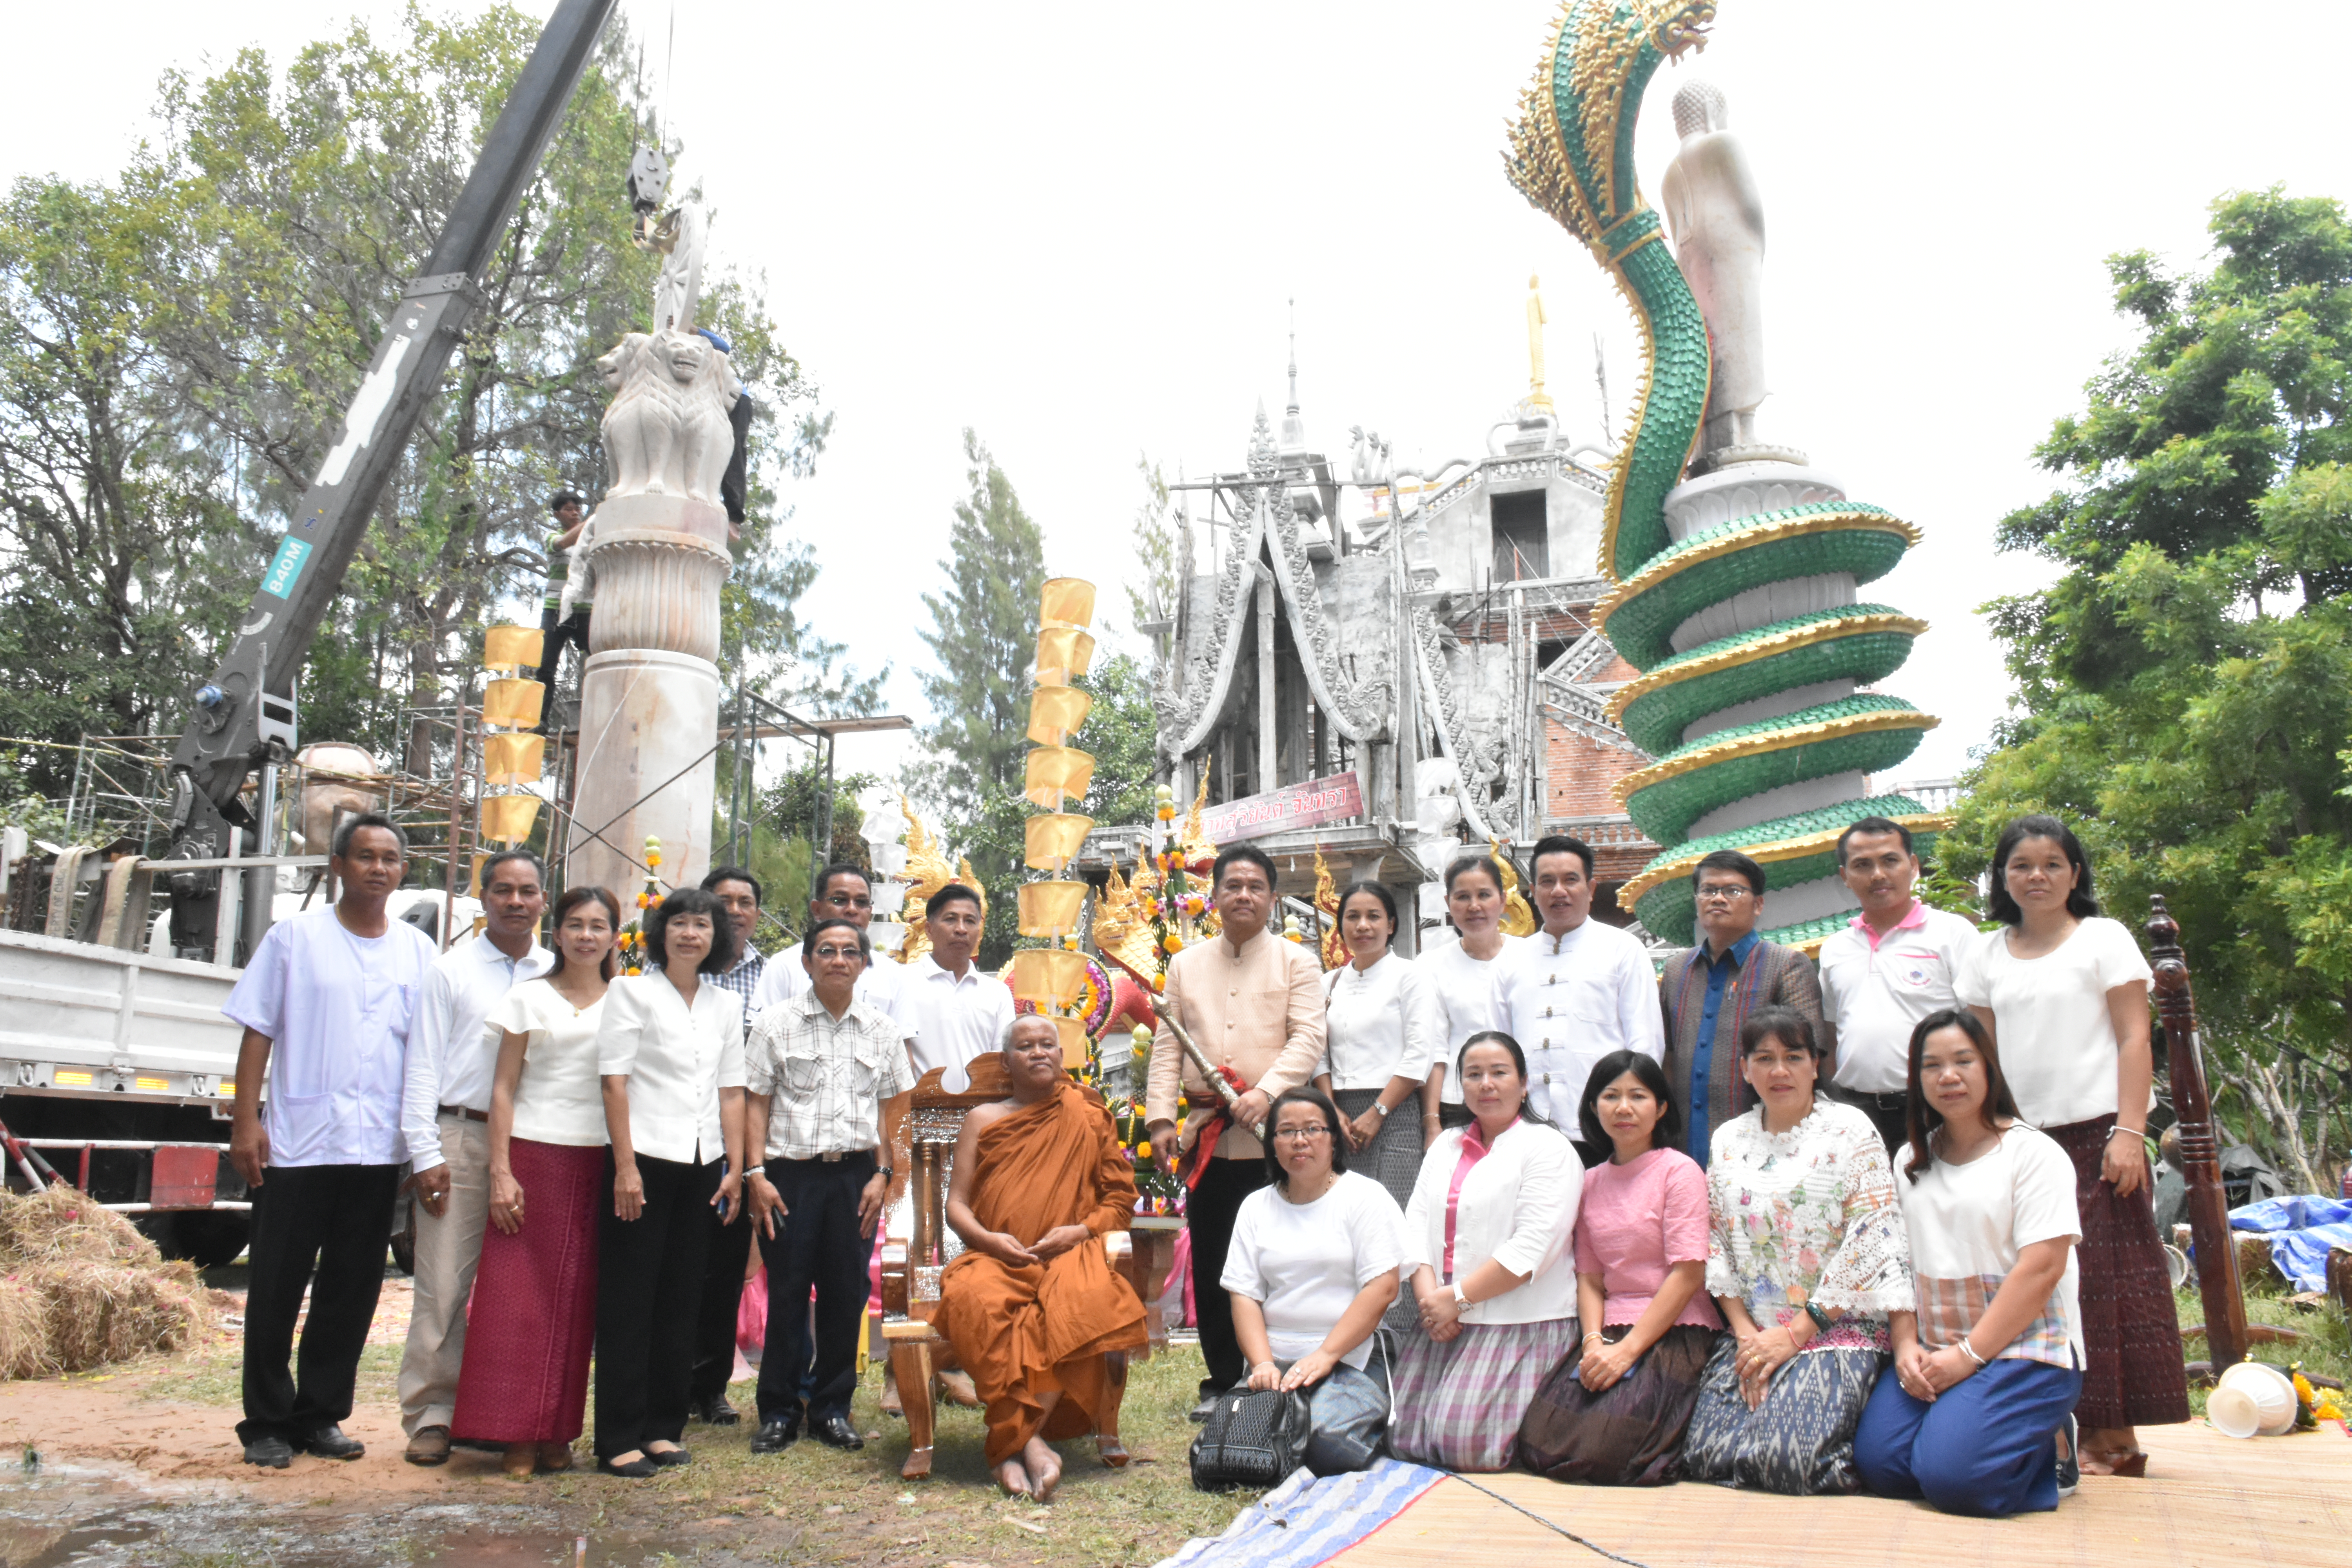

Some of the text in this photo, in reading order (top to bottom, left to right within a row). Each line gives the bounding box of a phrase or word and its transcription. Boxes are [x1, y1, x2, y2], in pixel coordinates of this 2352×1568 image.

[269, 542, 303, 593] 840M
[1291, 787, 1347, 815] จันทรา
